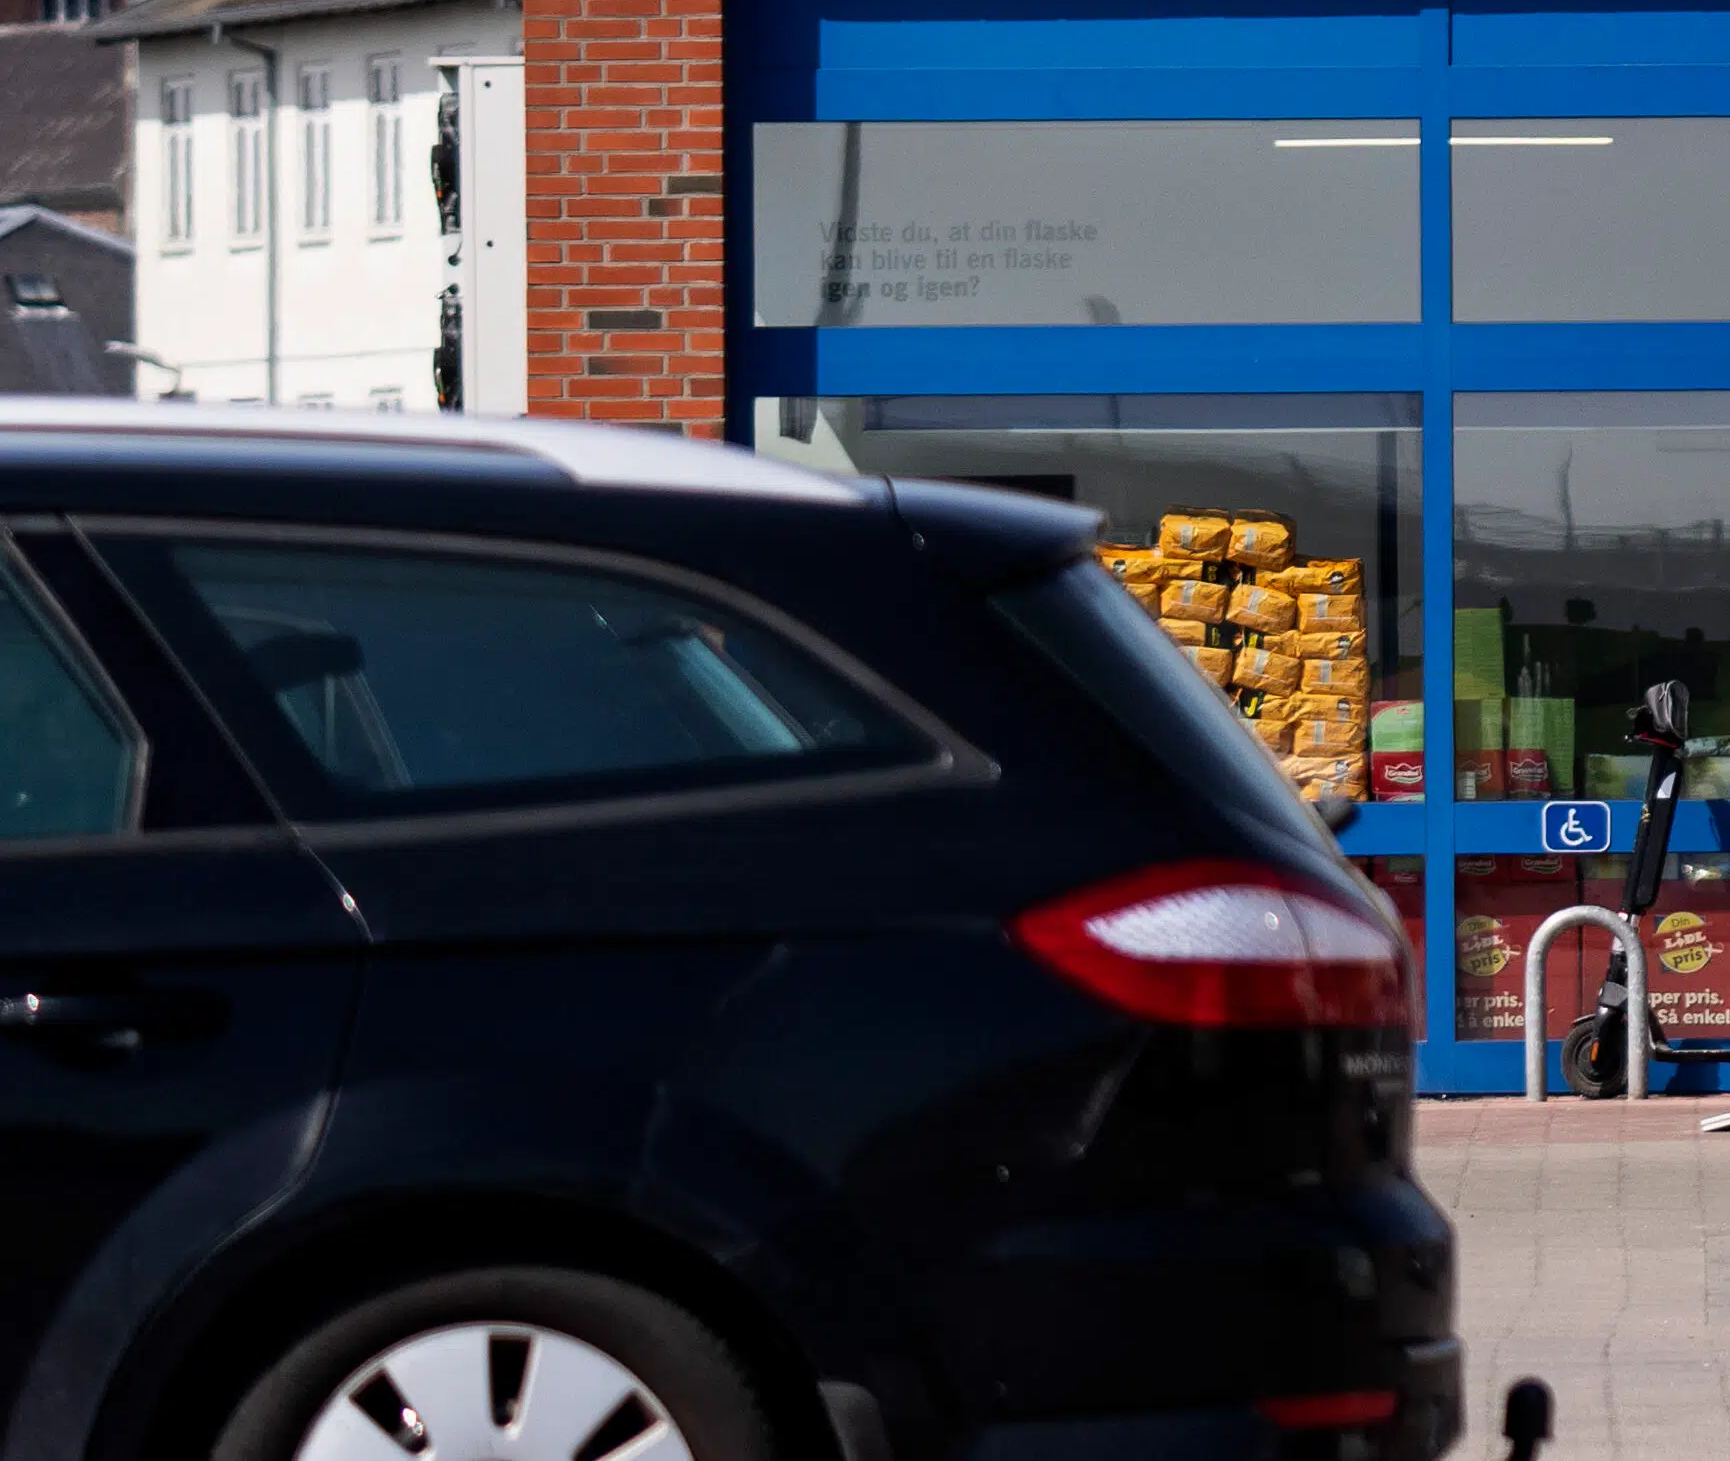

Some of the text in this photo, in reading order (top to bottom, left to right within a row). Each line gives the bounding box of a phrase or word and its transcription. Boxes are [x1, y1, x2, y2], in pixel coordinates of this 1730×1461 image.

[820, 219, 1098, 245] Vidste du, at din flaske
[821, 248, 1073, 271] kan blive til en flaske
[821, 275, 981, 303] igen og igen?
[1670, 917, 1691, 929] Din
[1470, 952, 1501, 972] pris
[1672, 949, 1704, 969] pris
[1456, 990, 1524, 1012] er pris.
[1648, 987, 1725, 1008] per pris.
[1482, 1010, 1526, 1029] enke
[1657, 1008, 1679, 1025] Så
